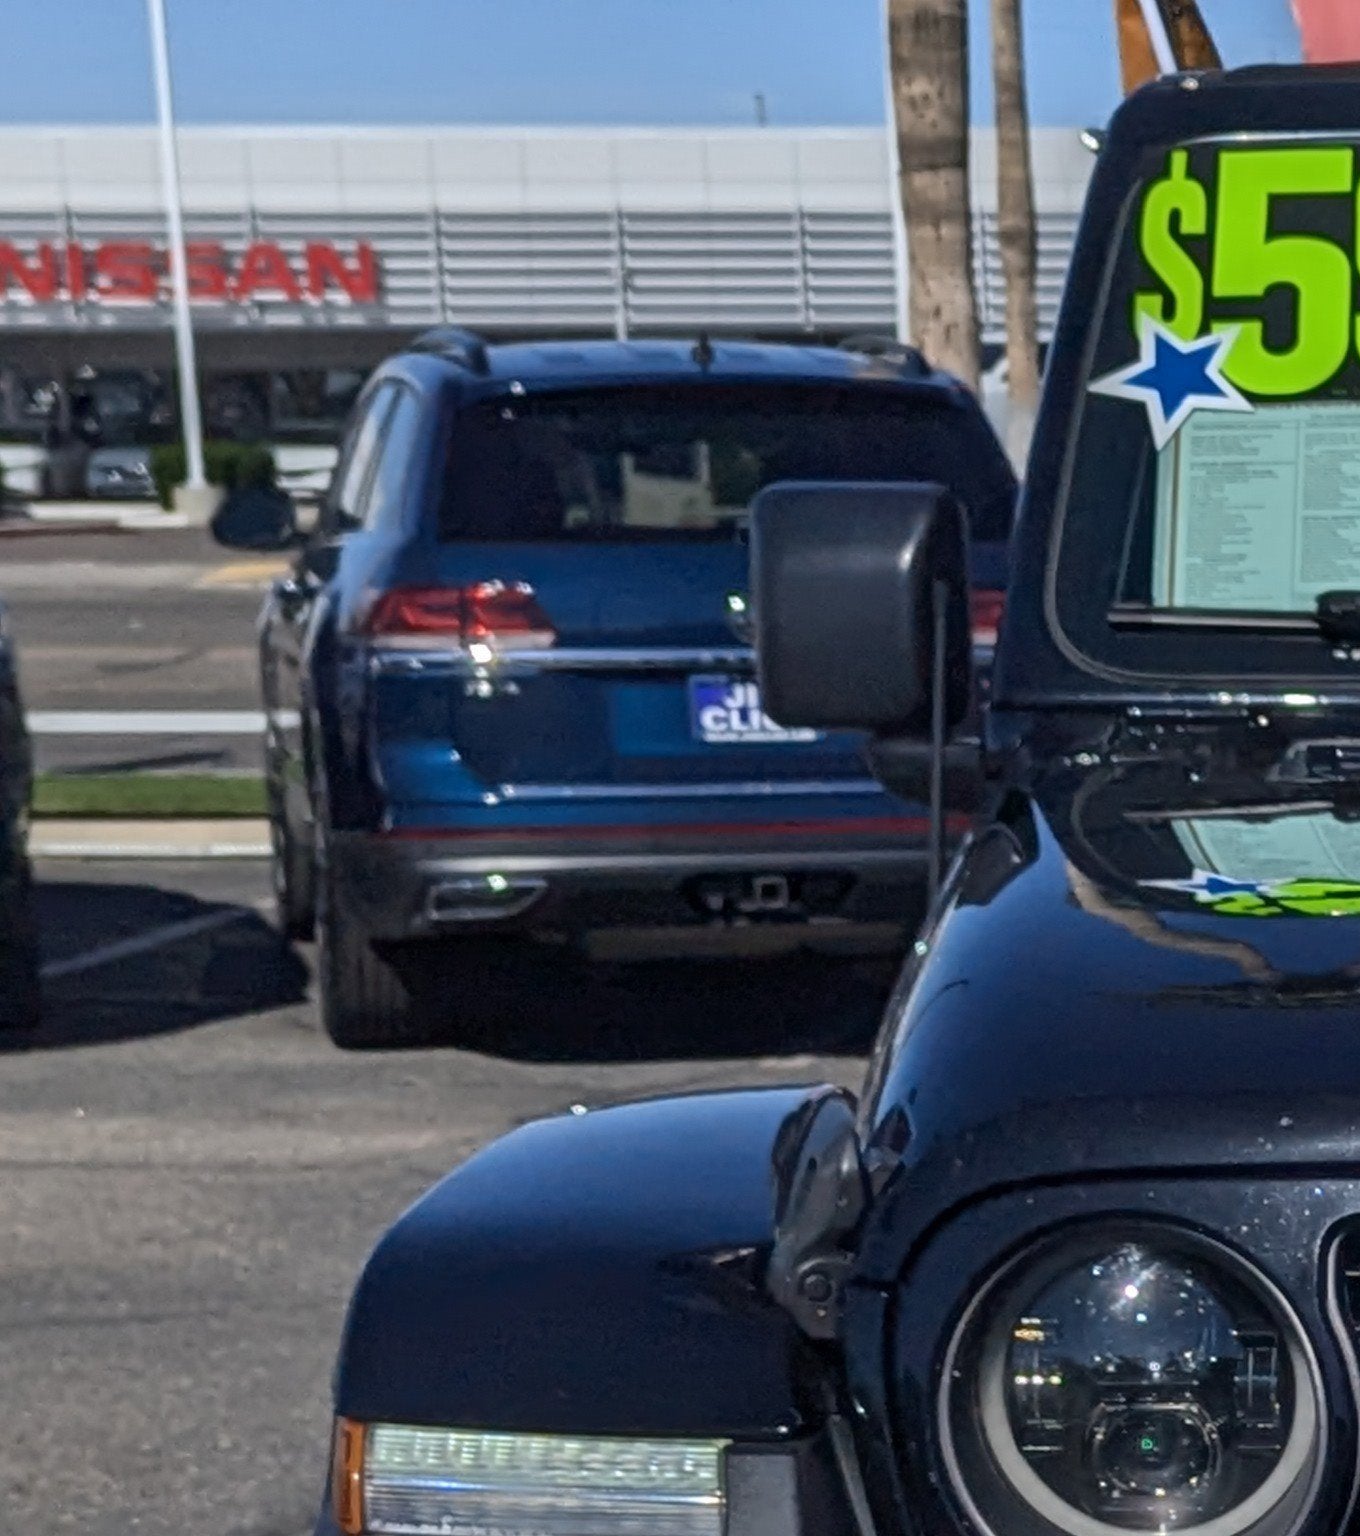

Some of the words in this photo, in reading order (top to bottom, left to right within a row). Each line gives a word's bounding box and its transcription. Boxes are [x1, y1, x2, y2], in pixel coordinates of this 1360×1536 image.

[0, 239, 377, 302] NISSAN
[724, 682, 760, 709] JI
[701, 705, 784, 731] CLI
